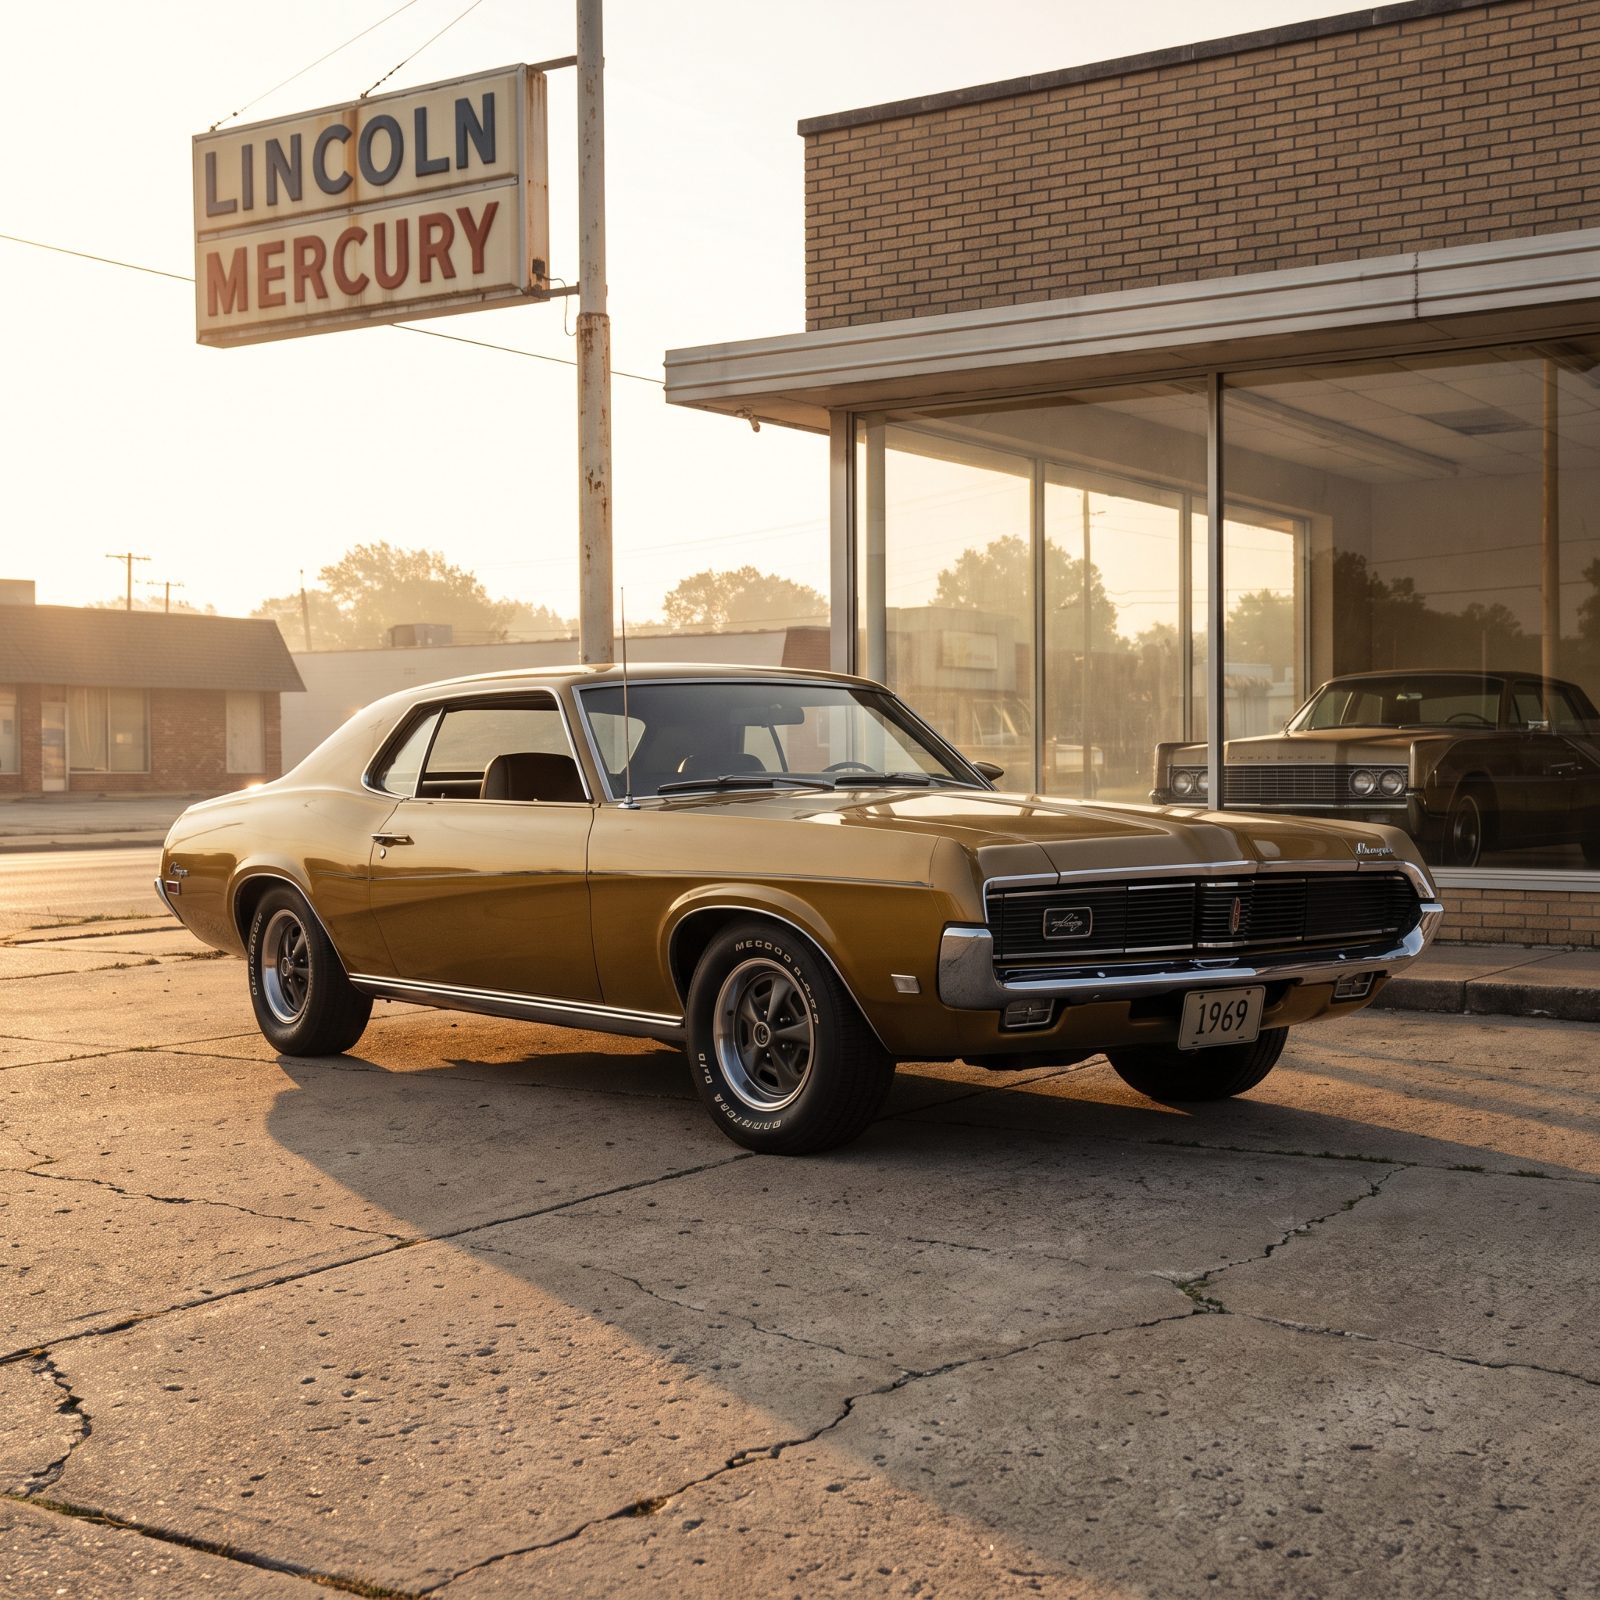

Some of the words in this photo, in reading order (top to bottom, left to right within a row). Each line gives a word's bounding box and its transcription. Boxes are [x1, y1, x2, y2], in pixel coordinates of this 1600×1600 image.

[205, 92, 496, 218] LINCOLN
[206, 201, 500, 317] MERCURY
[1195, 999, 1249, 1035] 1969
